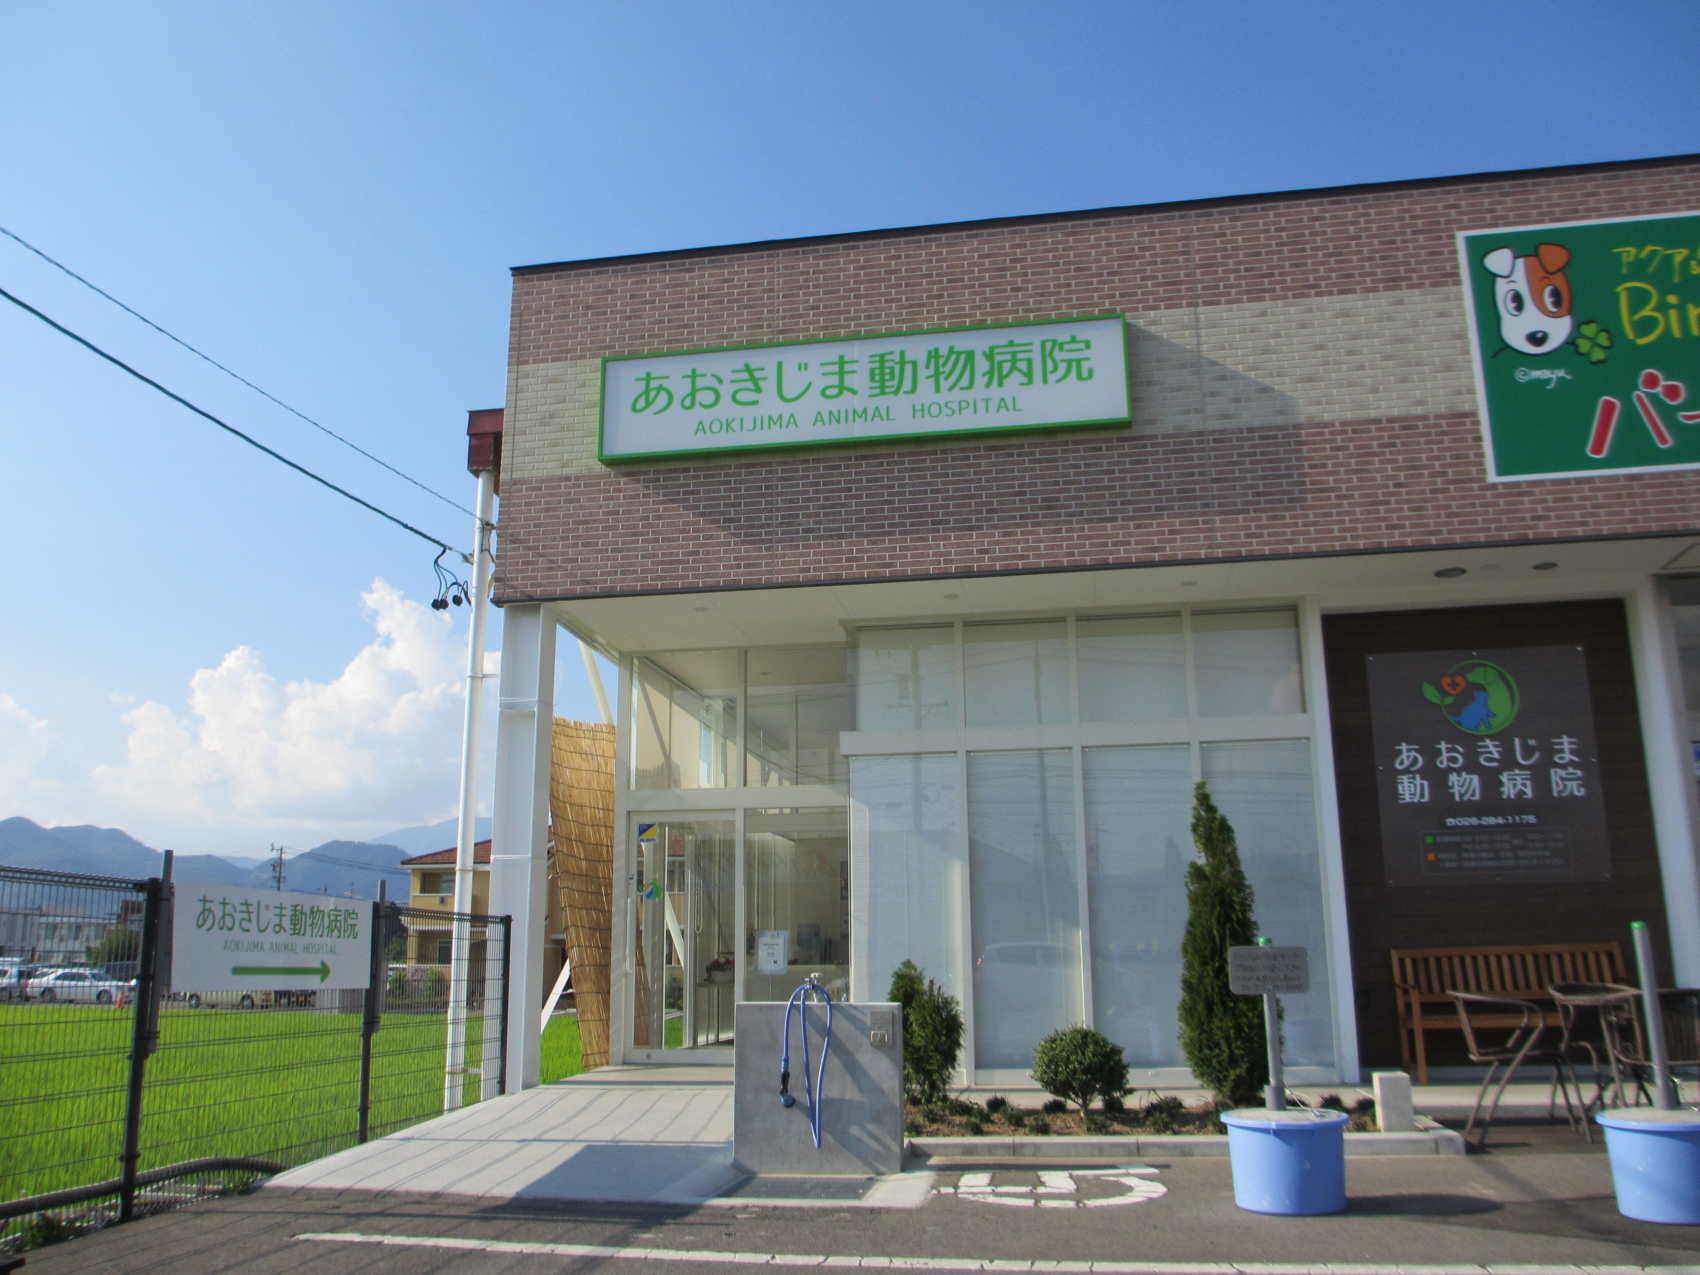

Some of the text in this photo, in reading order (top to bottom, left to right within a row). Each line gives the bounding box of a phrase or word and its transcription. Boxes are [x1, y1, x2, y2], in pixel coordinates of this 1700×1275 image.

[630, 334, 1094, 416] あおきじま動物病院
[694, 395, 1024, 436] AOKIJIMA ANIMAL HOSPITAL
[1393, 734, 1581, 771] あおきじま
[1395, 766, 1586, 804] 動物病院
[196, 895, 359, 940] あおきじま動物病院
[223, 939, 338, 956] AOKIJIMA ANIMAL HOSPITAL
